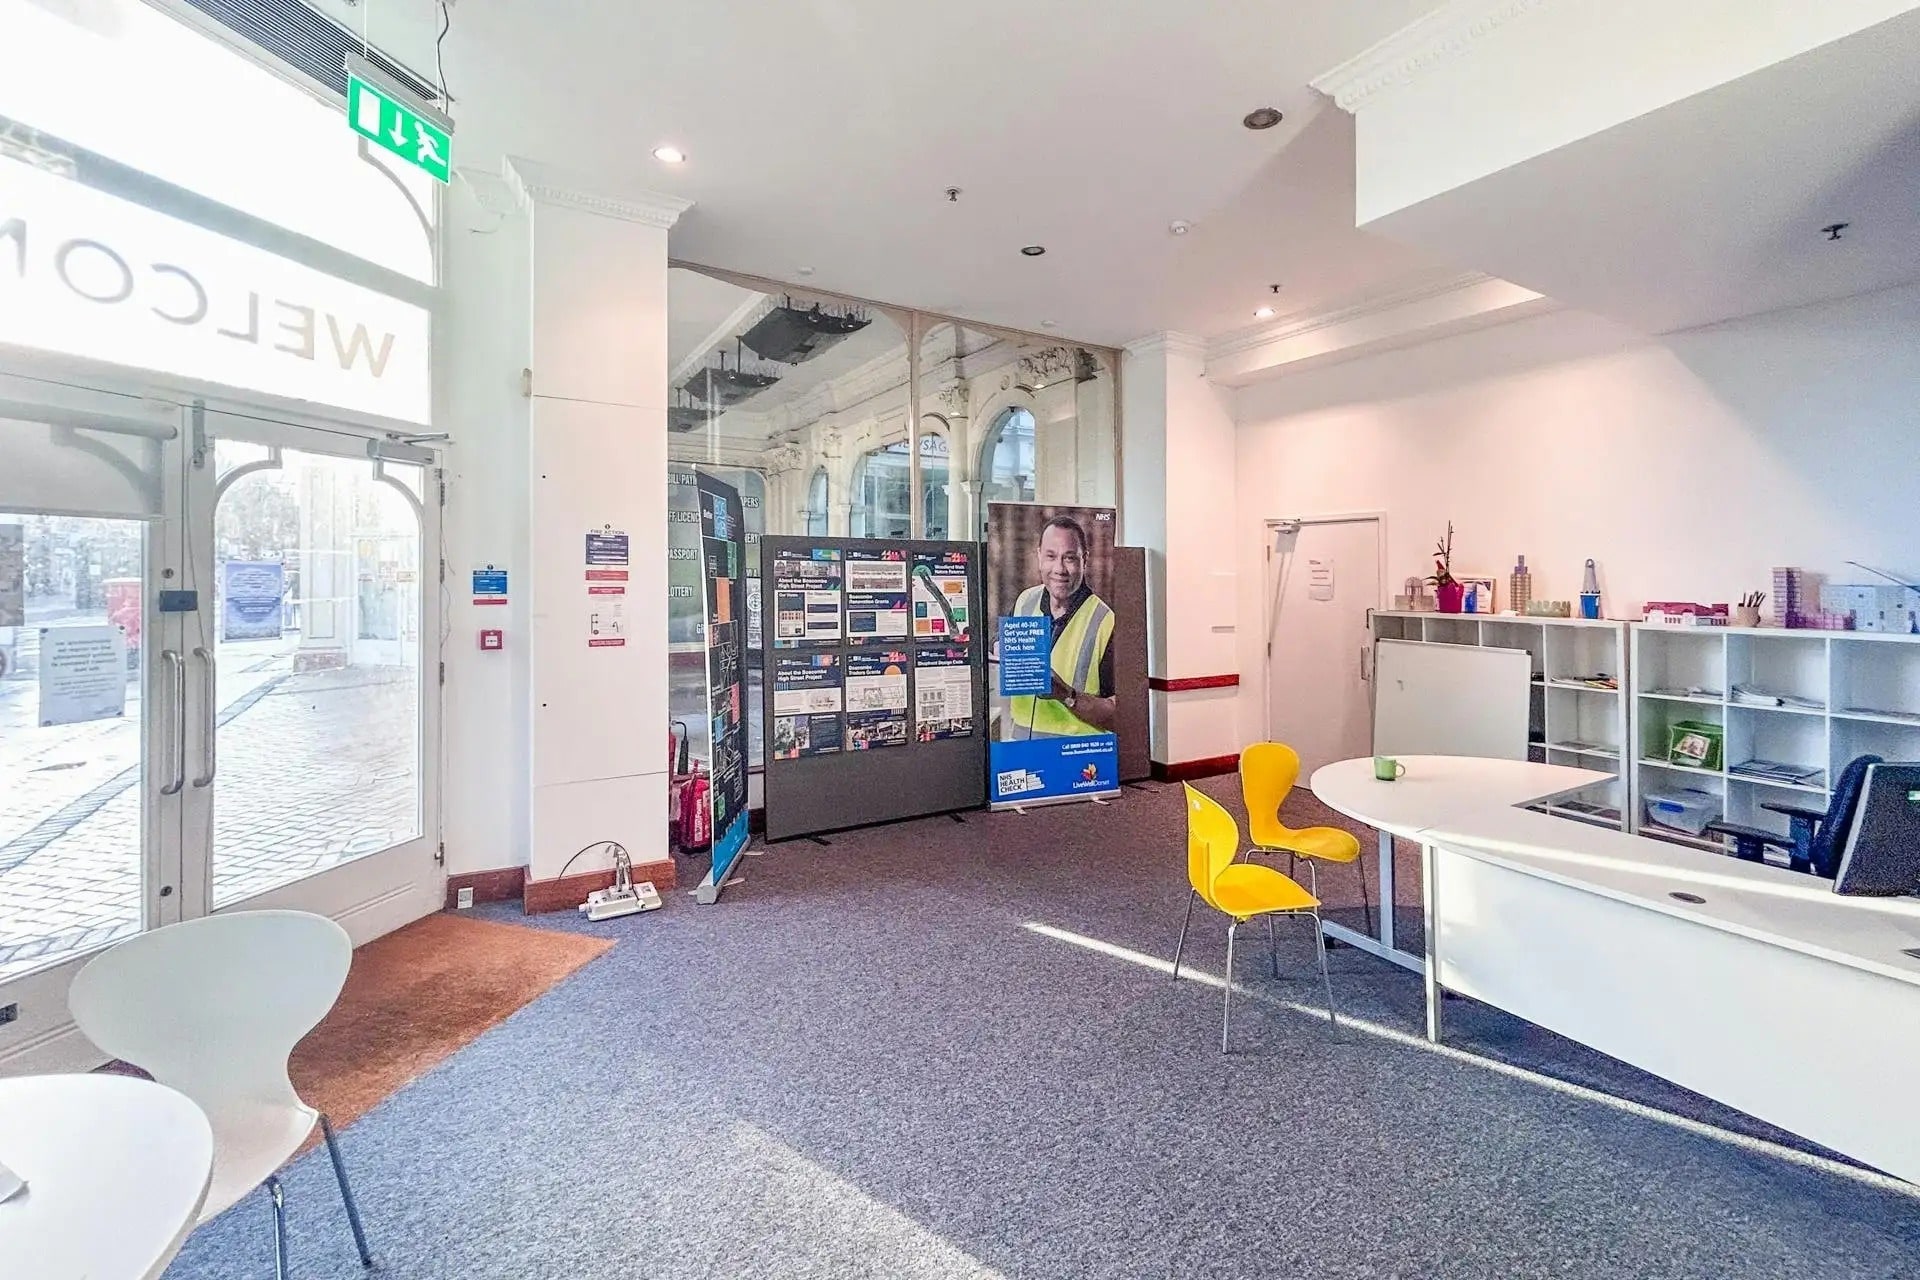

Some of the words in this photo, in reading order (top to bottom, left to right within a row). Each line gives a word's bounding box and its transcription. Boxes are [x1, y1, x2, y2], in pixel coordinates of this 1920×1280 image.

[677, 511, 700, 523] LICENC
[1095, 513, 1111, 521] NHS
[668, 549, 698, 560] ASSPORT
[1004, 622, 1020, 630] Aged
[1016, 630, 1028, 638] your
[1000, 778, 1025, 787] HEALTH
[1000, 784, 1022, 793] CHECK
